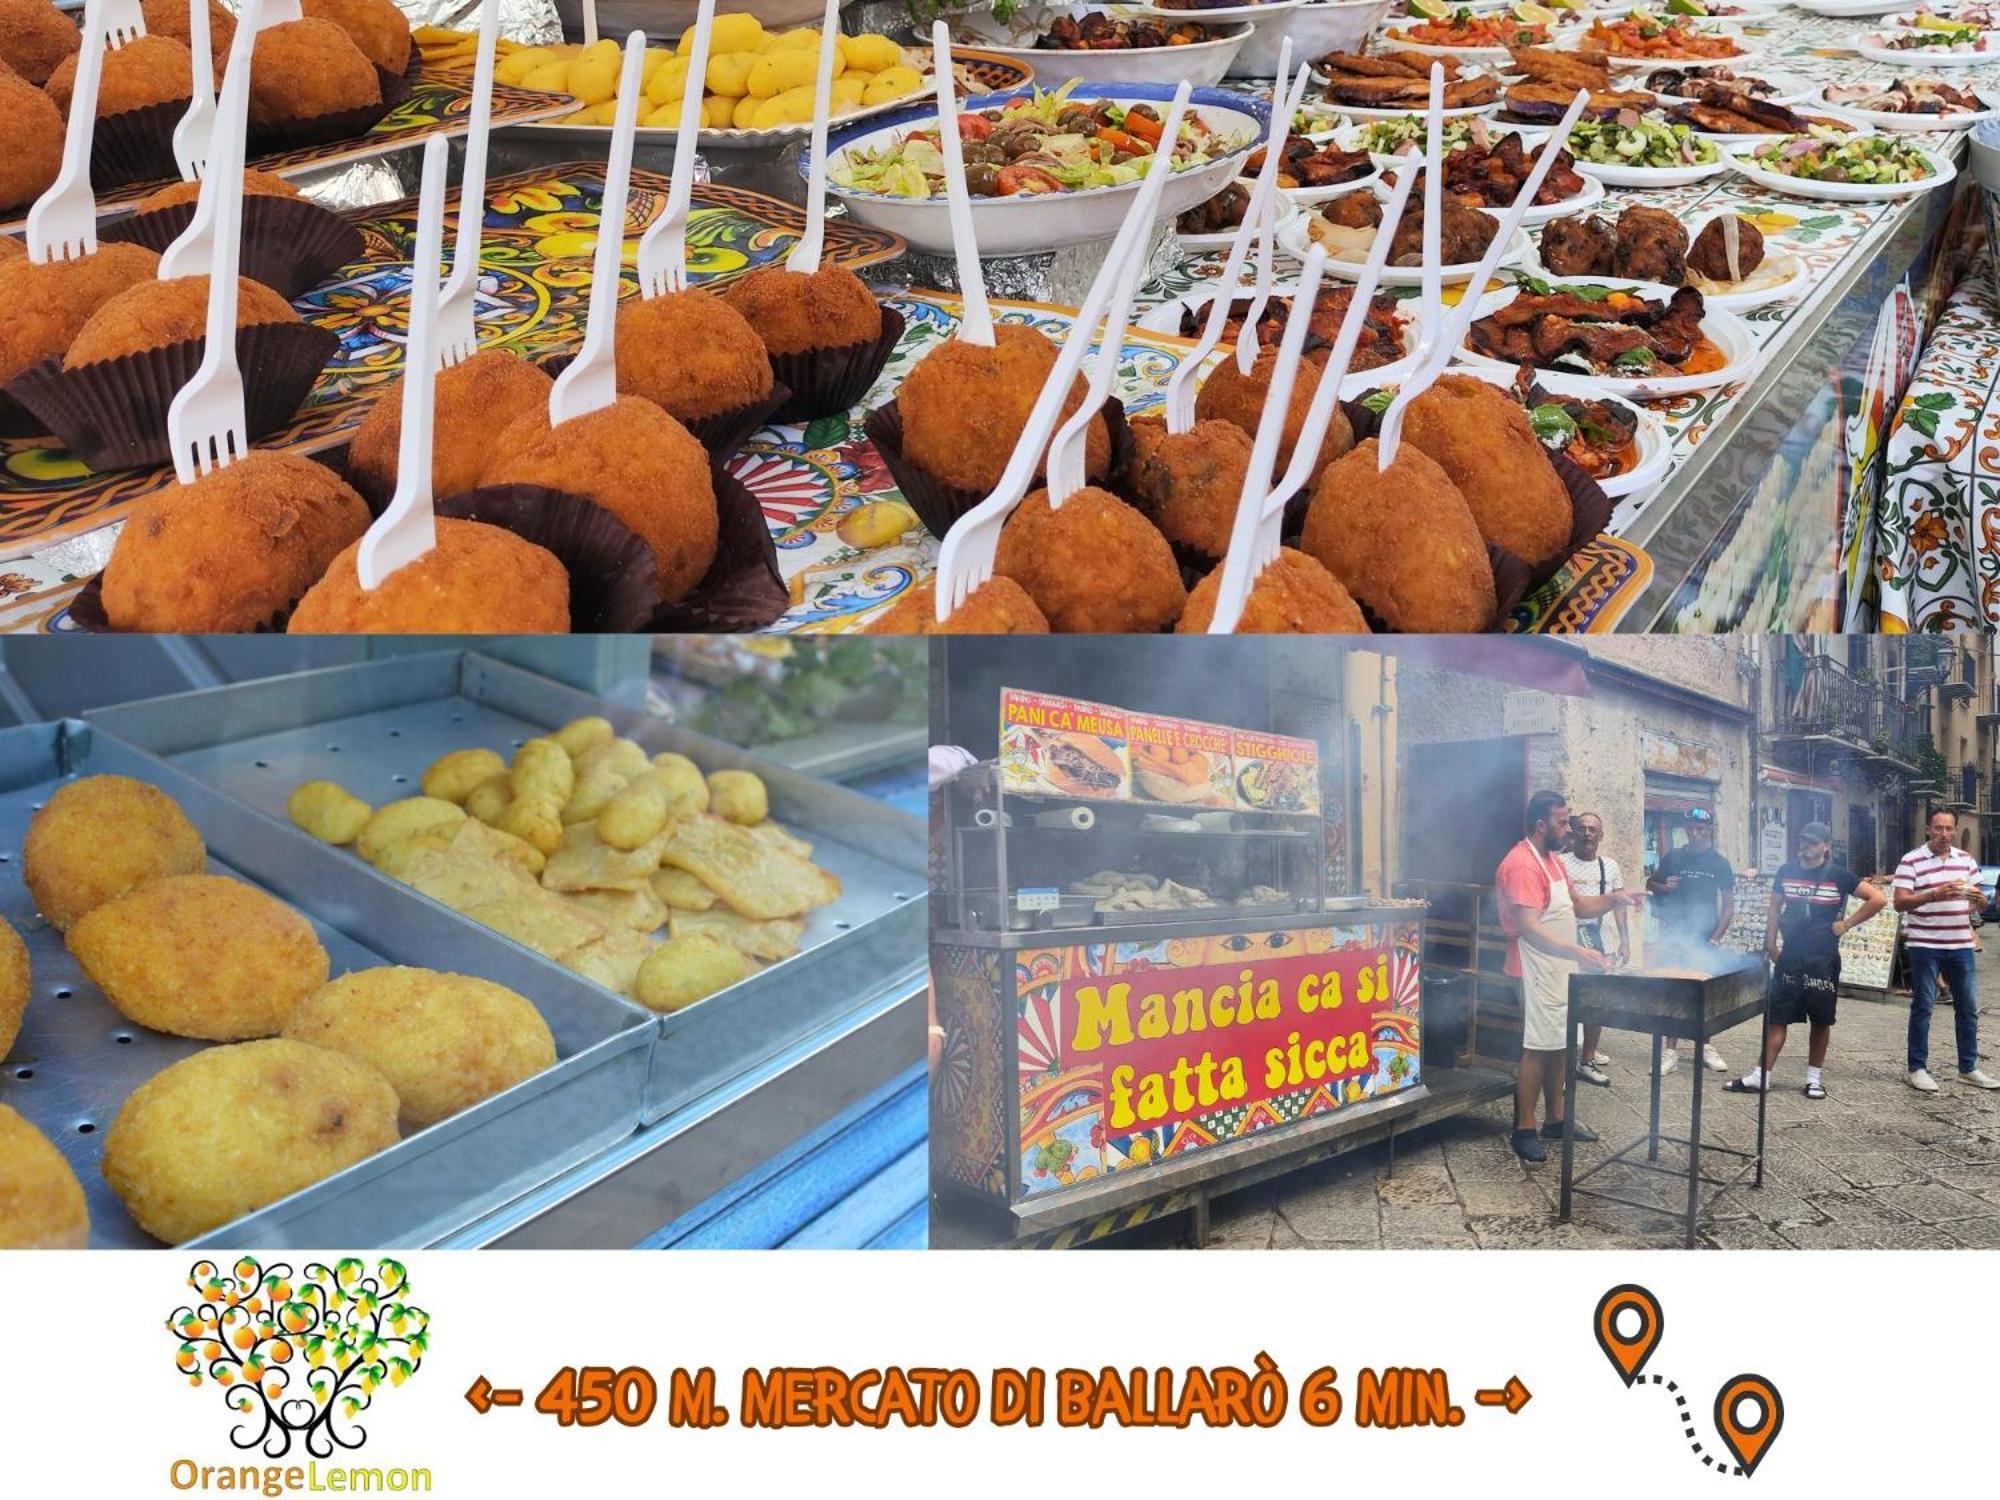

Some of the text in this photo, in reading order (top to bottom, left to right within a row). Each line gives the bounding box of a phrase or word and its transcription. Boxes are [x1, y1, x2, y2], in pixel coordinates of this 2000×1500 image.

[1008, 703, 1046, 726] PANI
[1077, 714, 1125, 737] MEUSA
[1130, 725, 1173, 747] PANELLE
[1071, 954, 1389, 1052] Mancia ca si
[1109, 1031, 1370, 1129] fatta sicca
